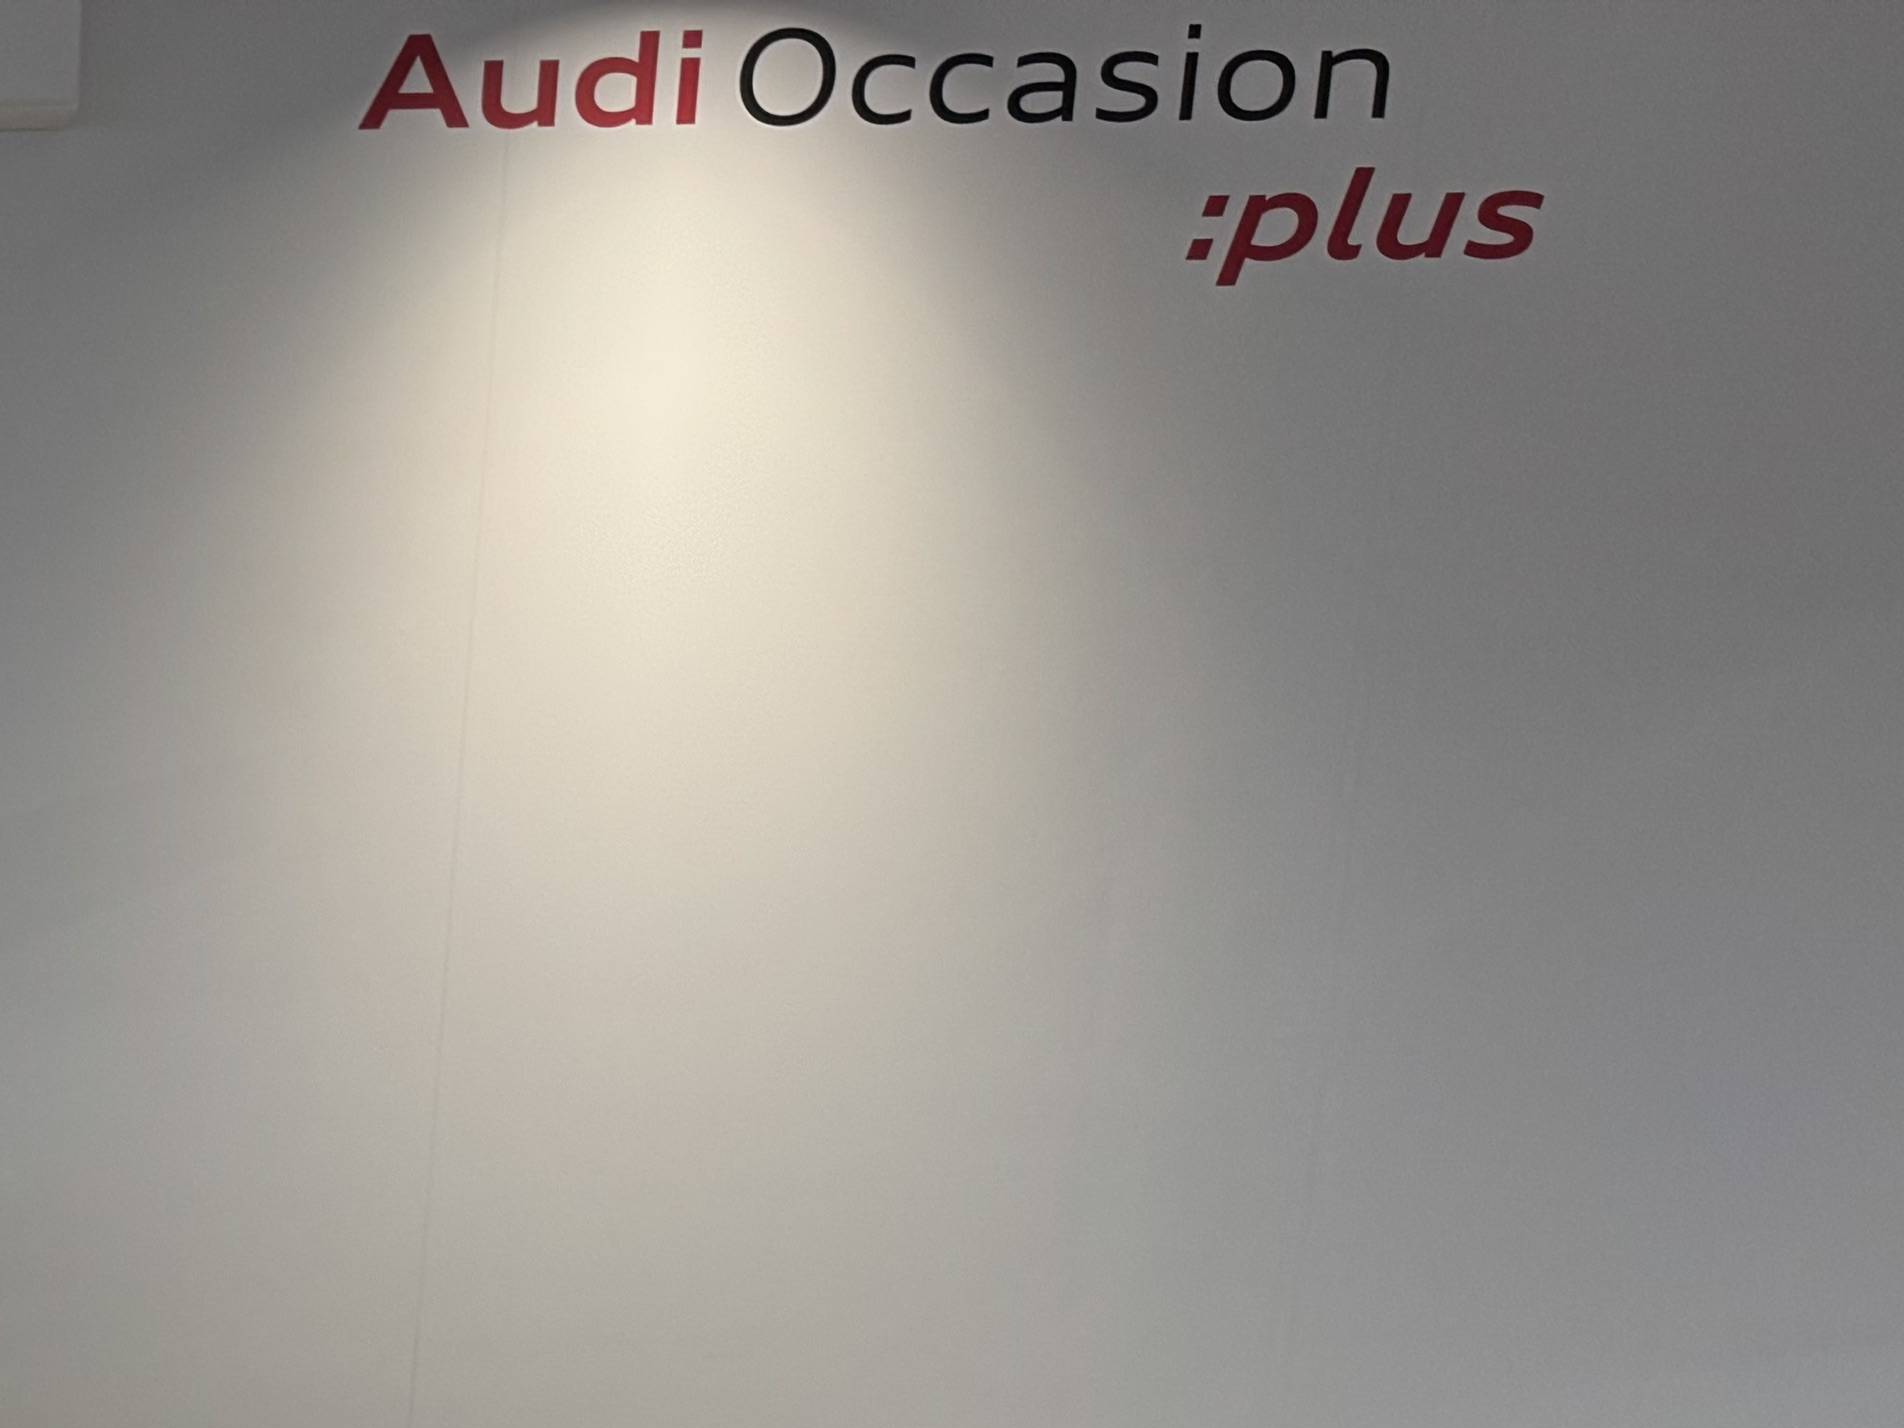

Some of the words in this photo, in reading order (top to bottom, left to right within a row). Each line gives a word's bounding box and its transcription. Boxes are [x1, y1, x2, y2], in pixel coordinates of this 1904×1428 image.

[358, 29, 703, 131] Audi
[737, 22, 1393, 127] Occasion
[1184, 165, 1546, 287] :plus
